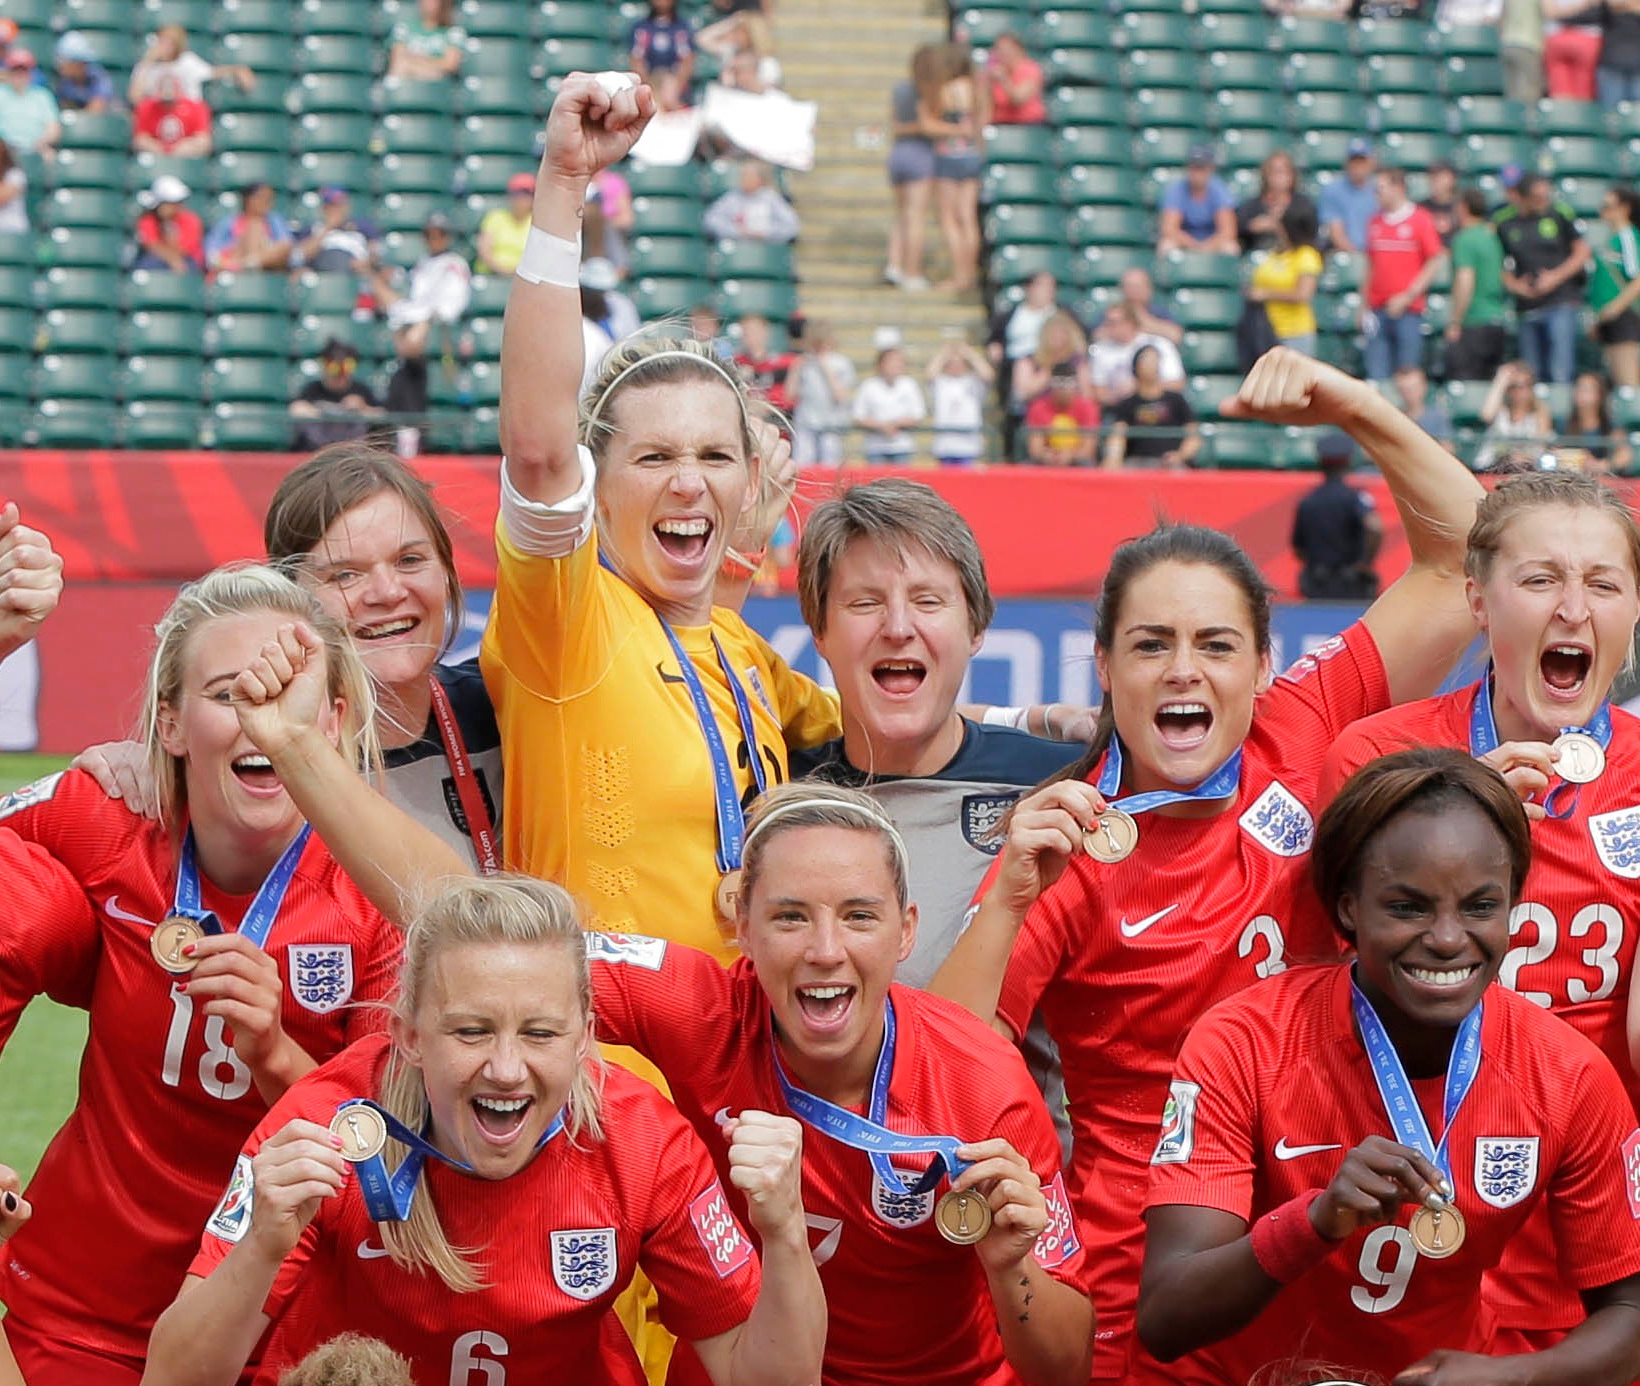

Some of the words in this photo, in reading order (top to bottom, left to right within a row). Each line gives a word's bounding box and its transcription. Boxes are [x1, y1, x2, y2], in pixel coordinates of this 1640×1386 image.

[251, 909, 264, 933] FIFA
[1497, 902, 1624, 1008] 23
[162, 982, 252, 1101] 18
[707, 1213, 733, 1243] YOU
[1350, 1225, 1418, 1314] 9
